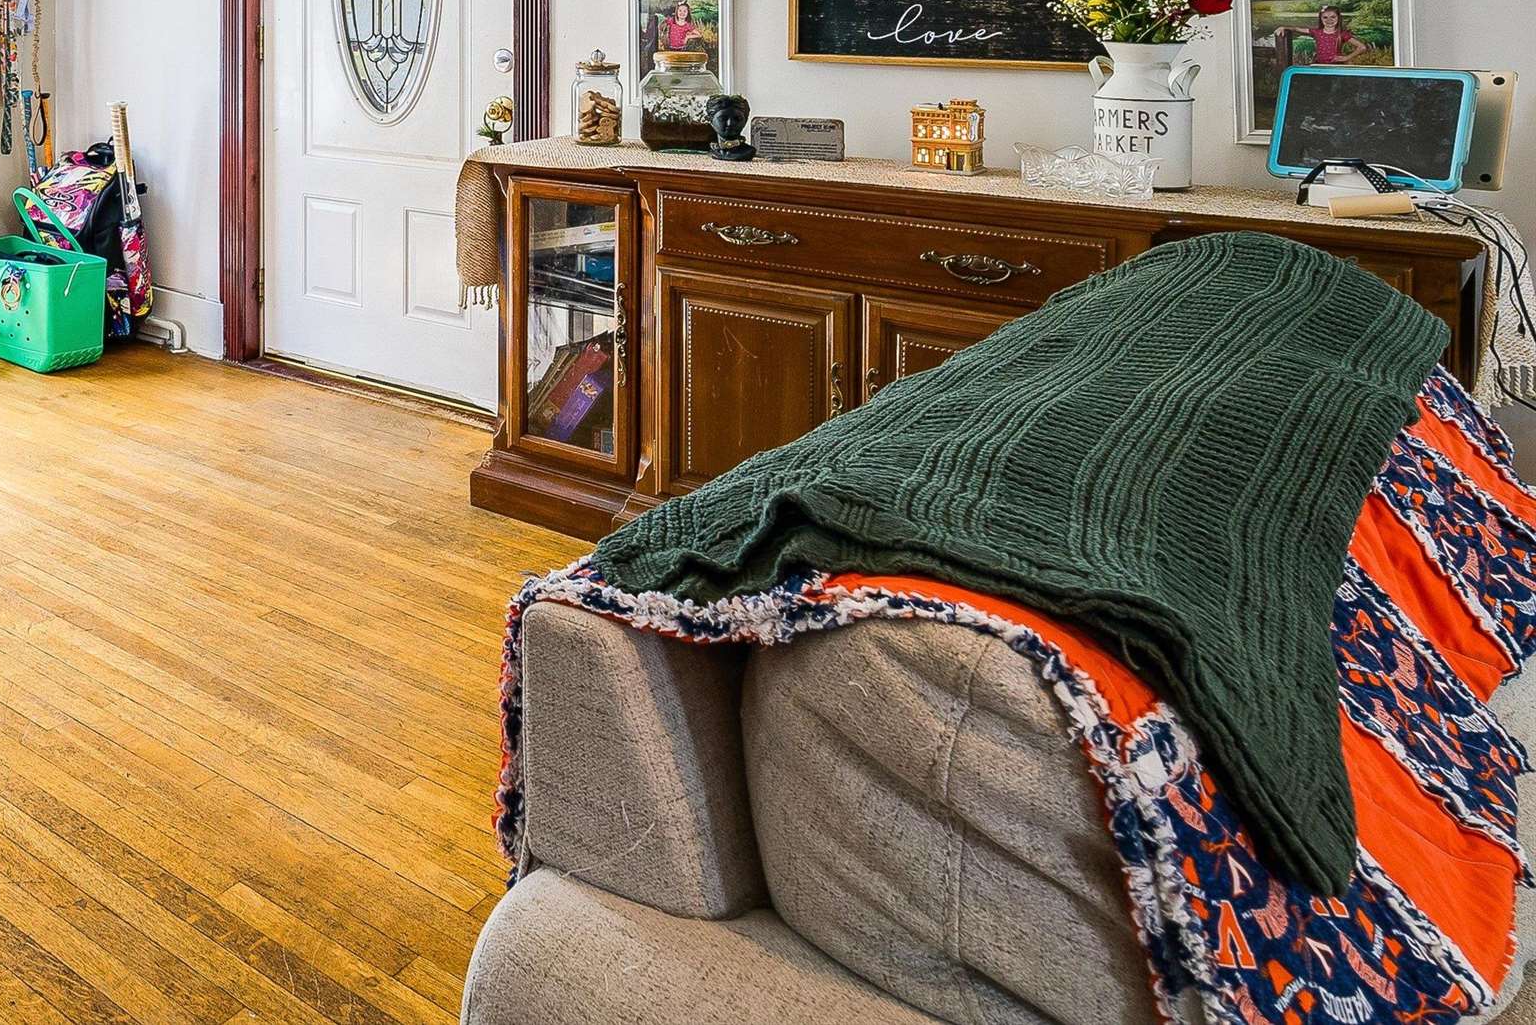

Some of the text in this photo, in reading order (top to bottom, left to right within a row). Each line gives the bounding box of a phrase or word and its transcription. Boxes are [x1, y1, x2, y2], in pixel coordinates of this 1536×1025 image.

[867, 3, 1003, 44] love
[1094, 108, 1169, 136] RMERS
[1094, 134, 1154, 154] ARKET
